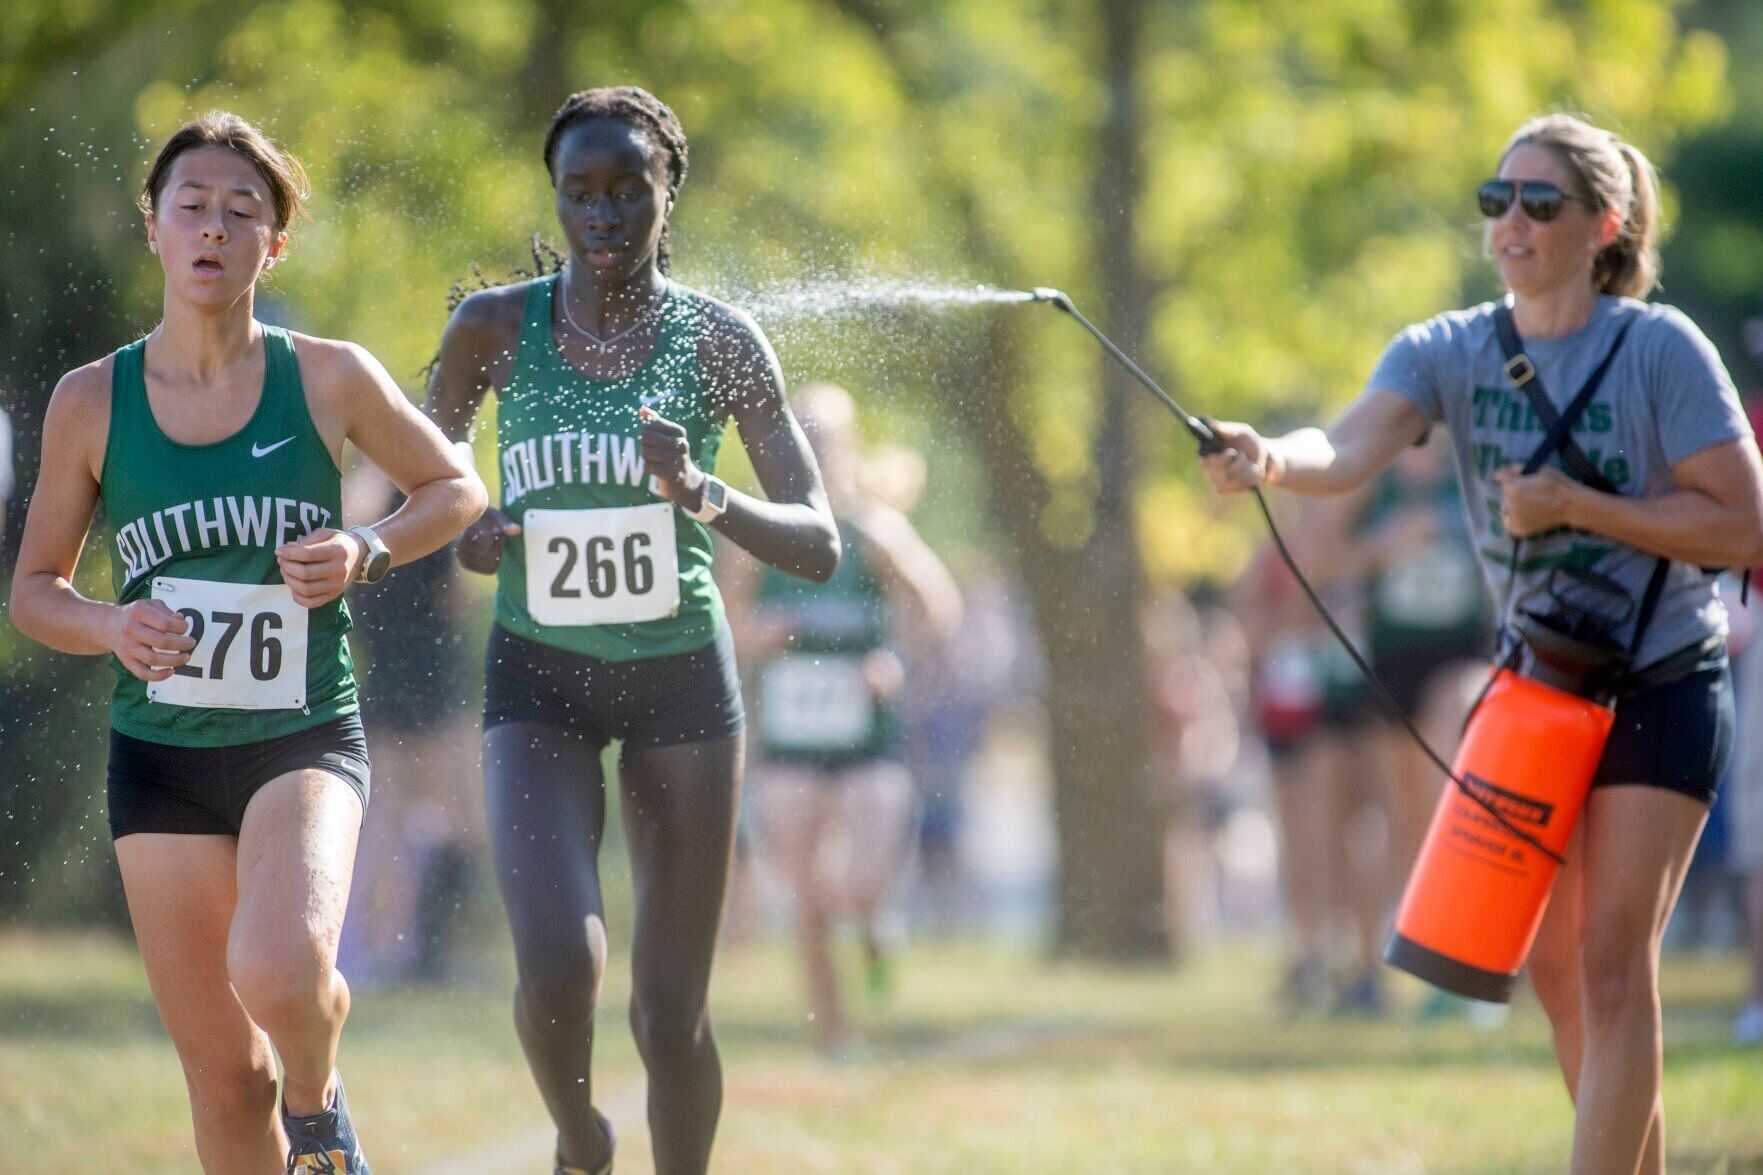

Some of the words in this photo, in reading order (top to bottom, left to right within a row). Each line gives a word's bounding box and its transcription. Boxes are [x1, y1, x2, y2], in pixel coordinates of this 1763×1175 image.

[502, 432, 661, 506] SOUTHW
[547, 532, 654, 599] 266
[172, 607, 283, 681] 276
